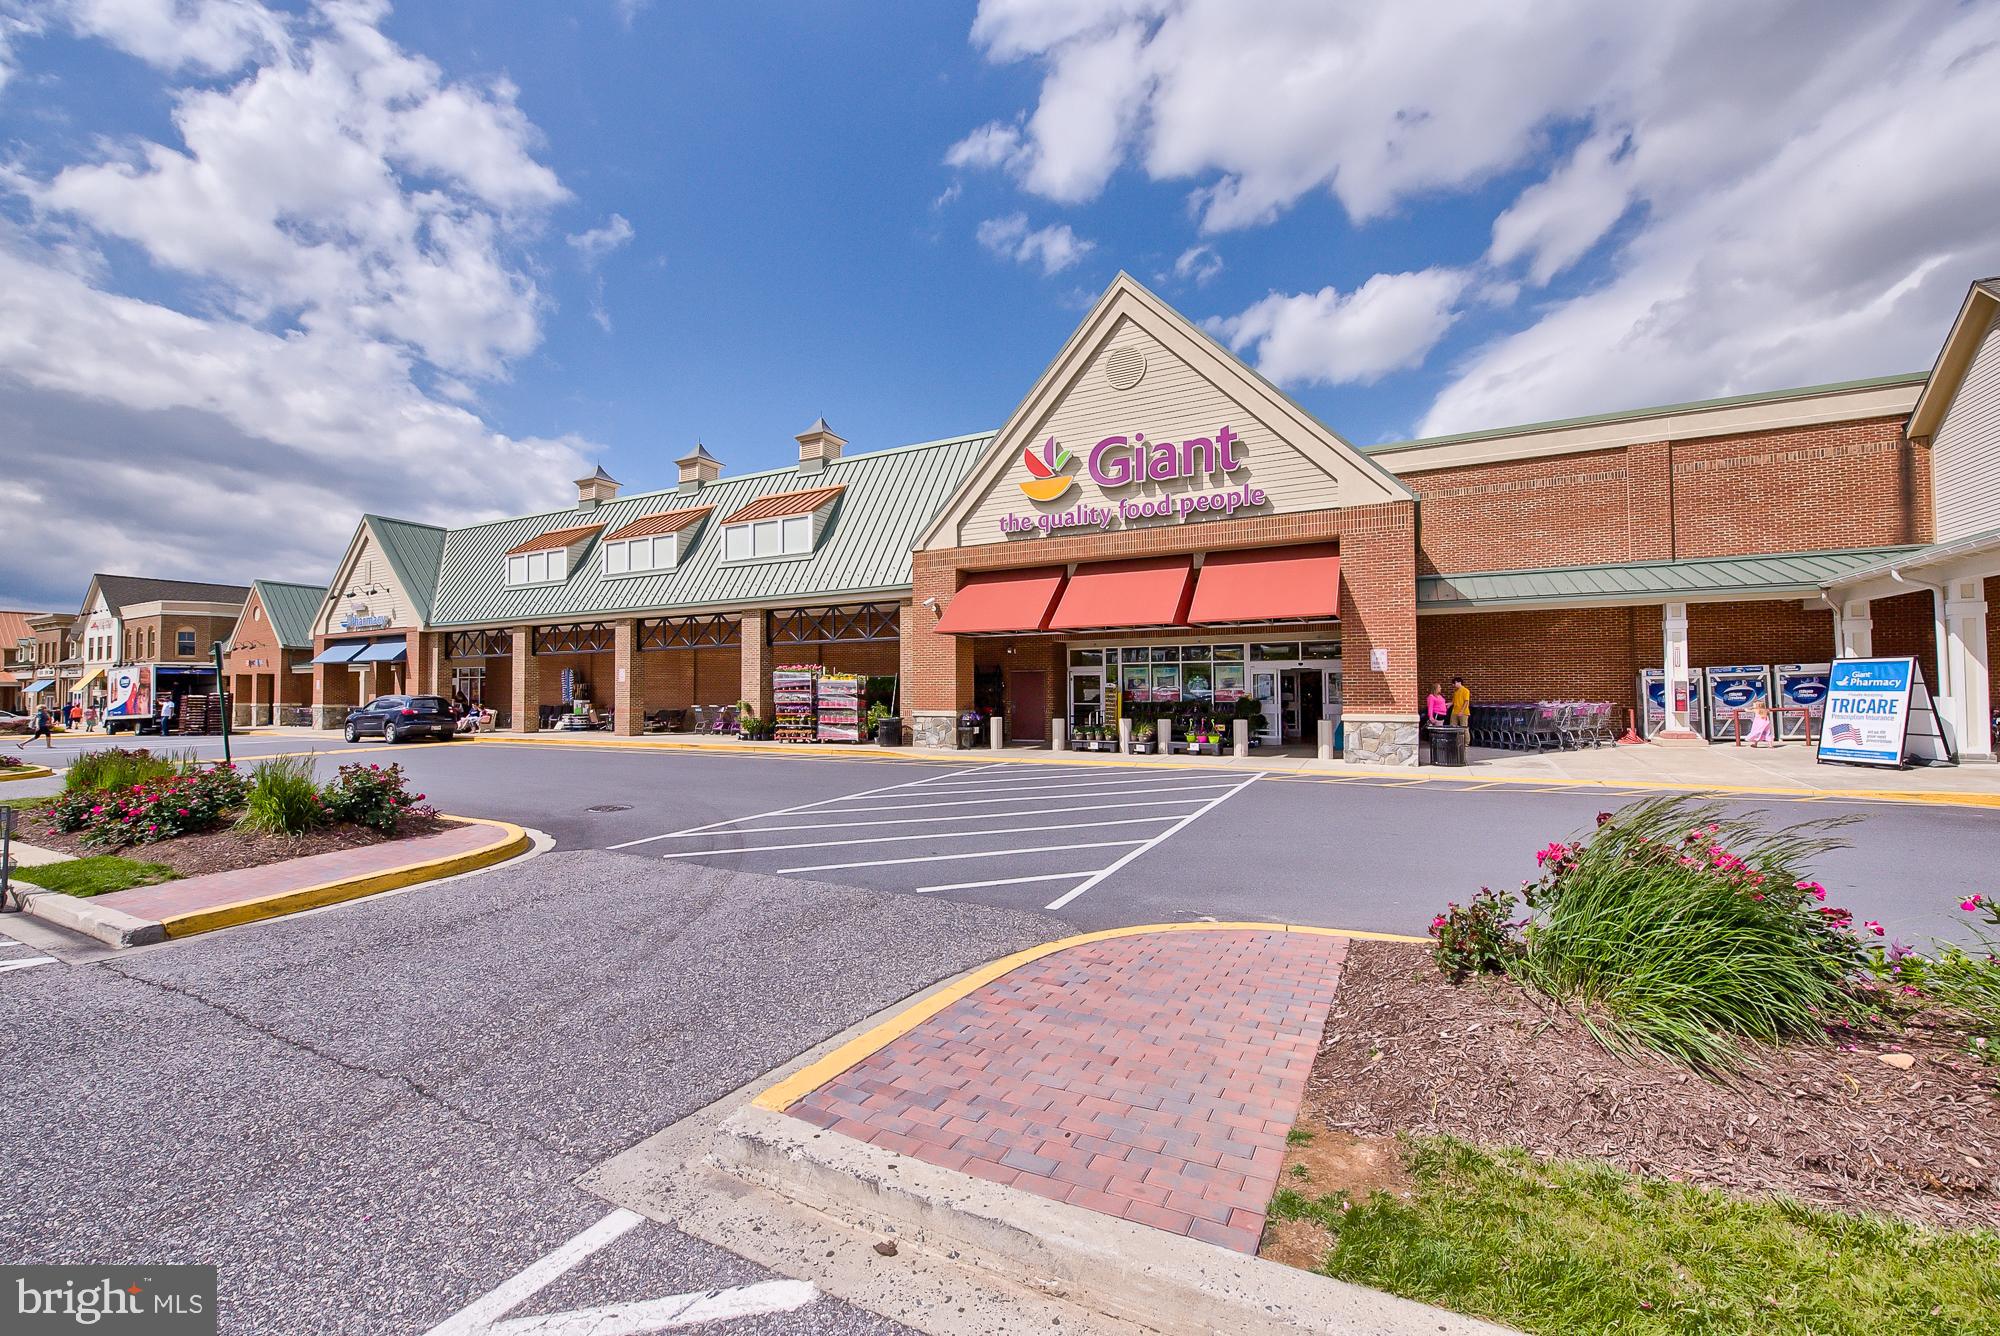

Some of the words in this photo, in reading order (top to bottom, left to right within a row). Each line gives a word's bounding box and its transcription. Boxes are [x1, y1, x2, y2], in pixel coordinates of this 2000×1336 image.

[1088, 424, 1242, 487] Giant
[999, 512, 1031, 532] the
[1037, 504, 1113, 534] quality
[1118, 494, 1171, 520] food
[1179, 484, 1266, 518] people
[351, 614, 386, 628] Pharmacy
[1850, 678, 1902, 688] Pharmacy
[1831, 698, 1899, 715] TRICARE
